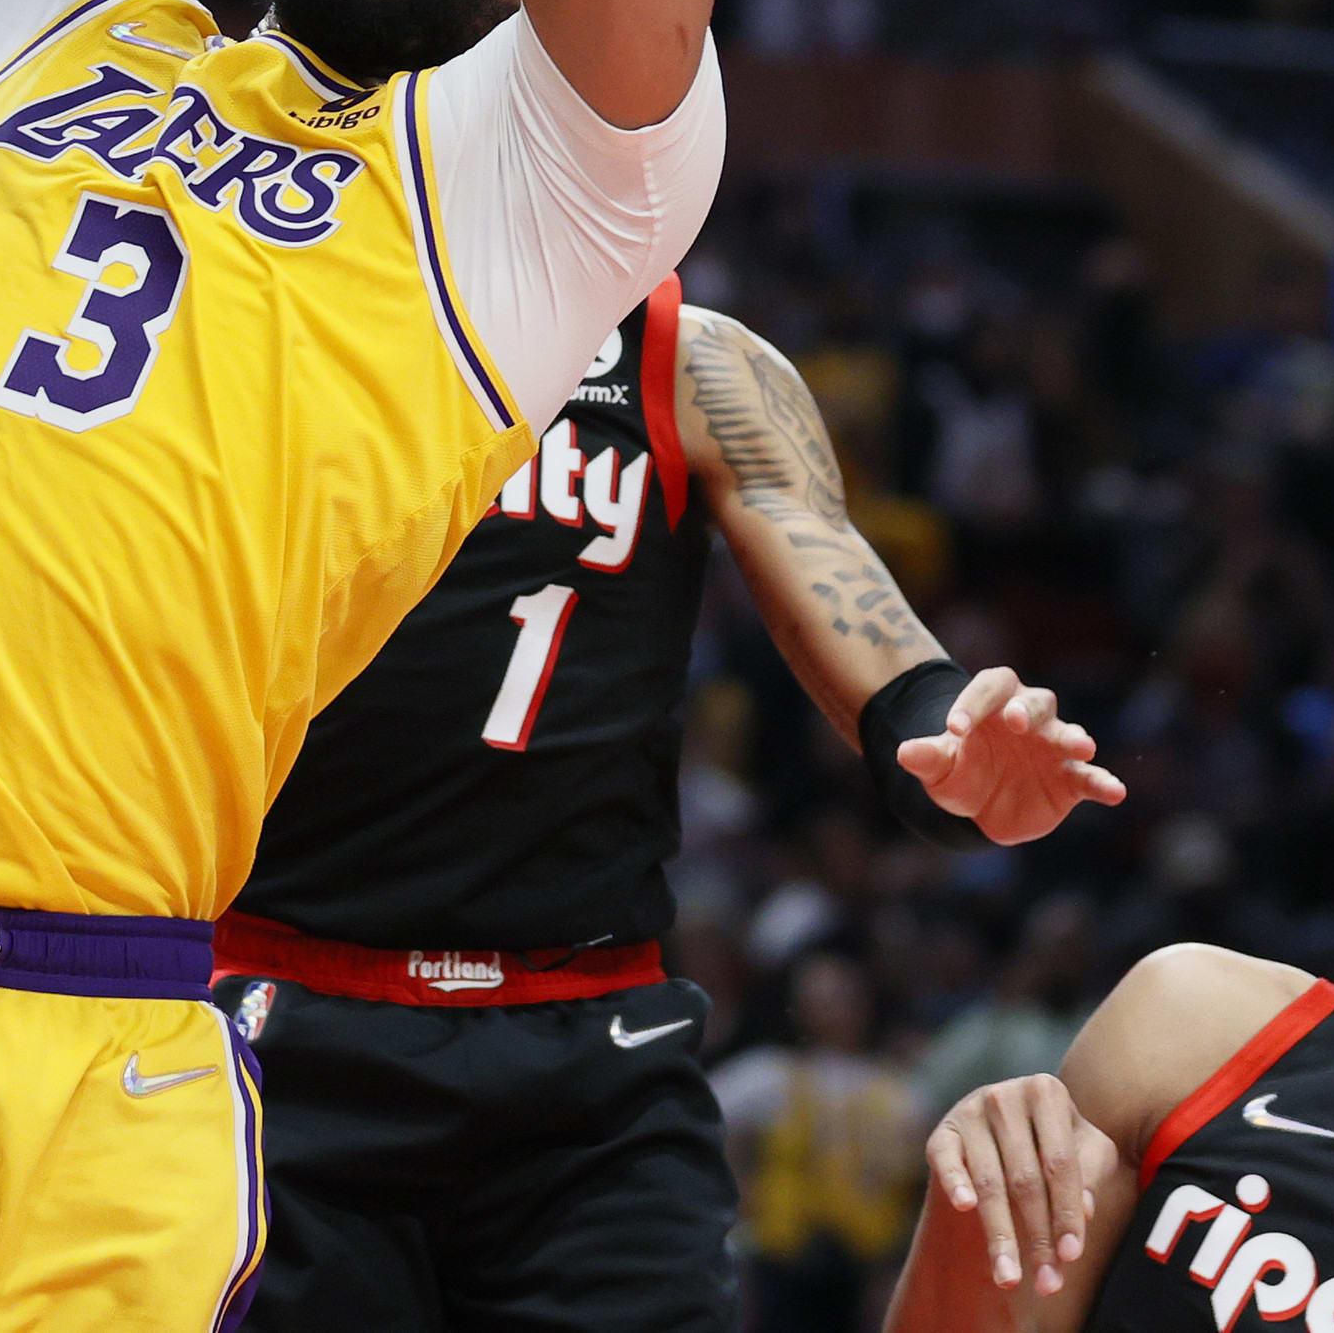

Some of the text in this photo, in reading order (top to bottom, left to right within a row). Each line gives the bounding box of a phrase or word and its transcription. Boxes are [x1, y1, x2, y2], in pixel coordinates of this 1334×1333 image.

[482, 418, 655, 575] ity
[481, 582, 579, 753] 1
[408, 950, 504, 982] Portland
